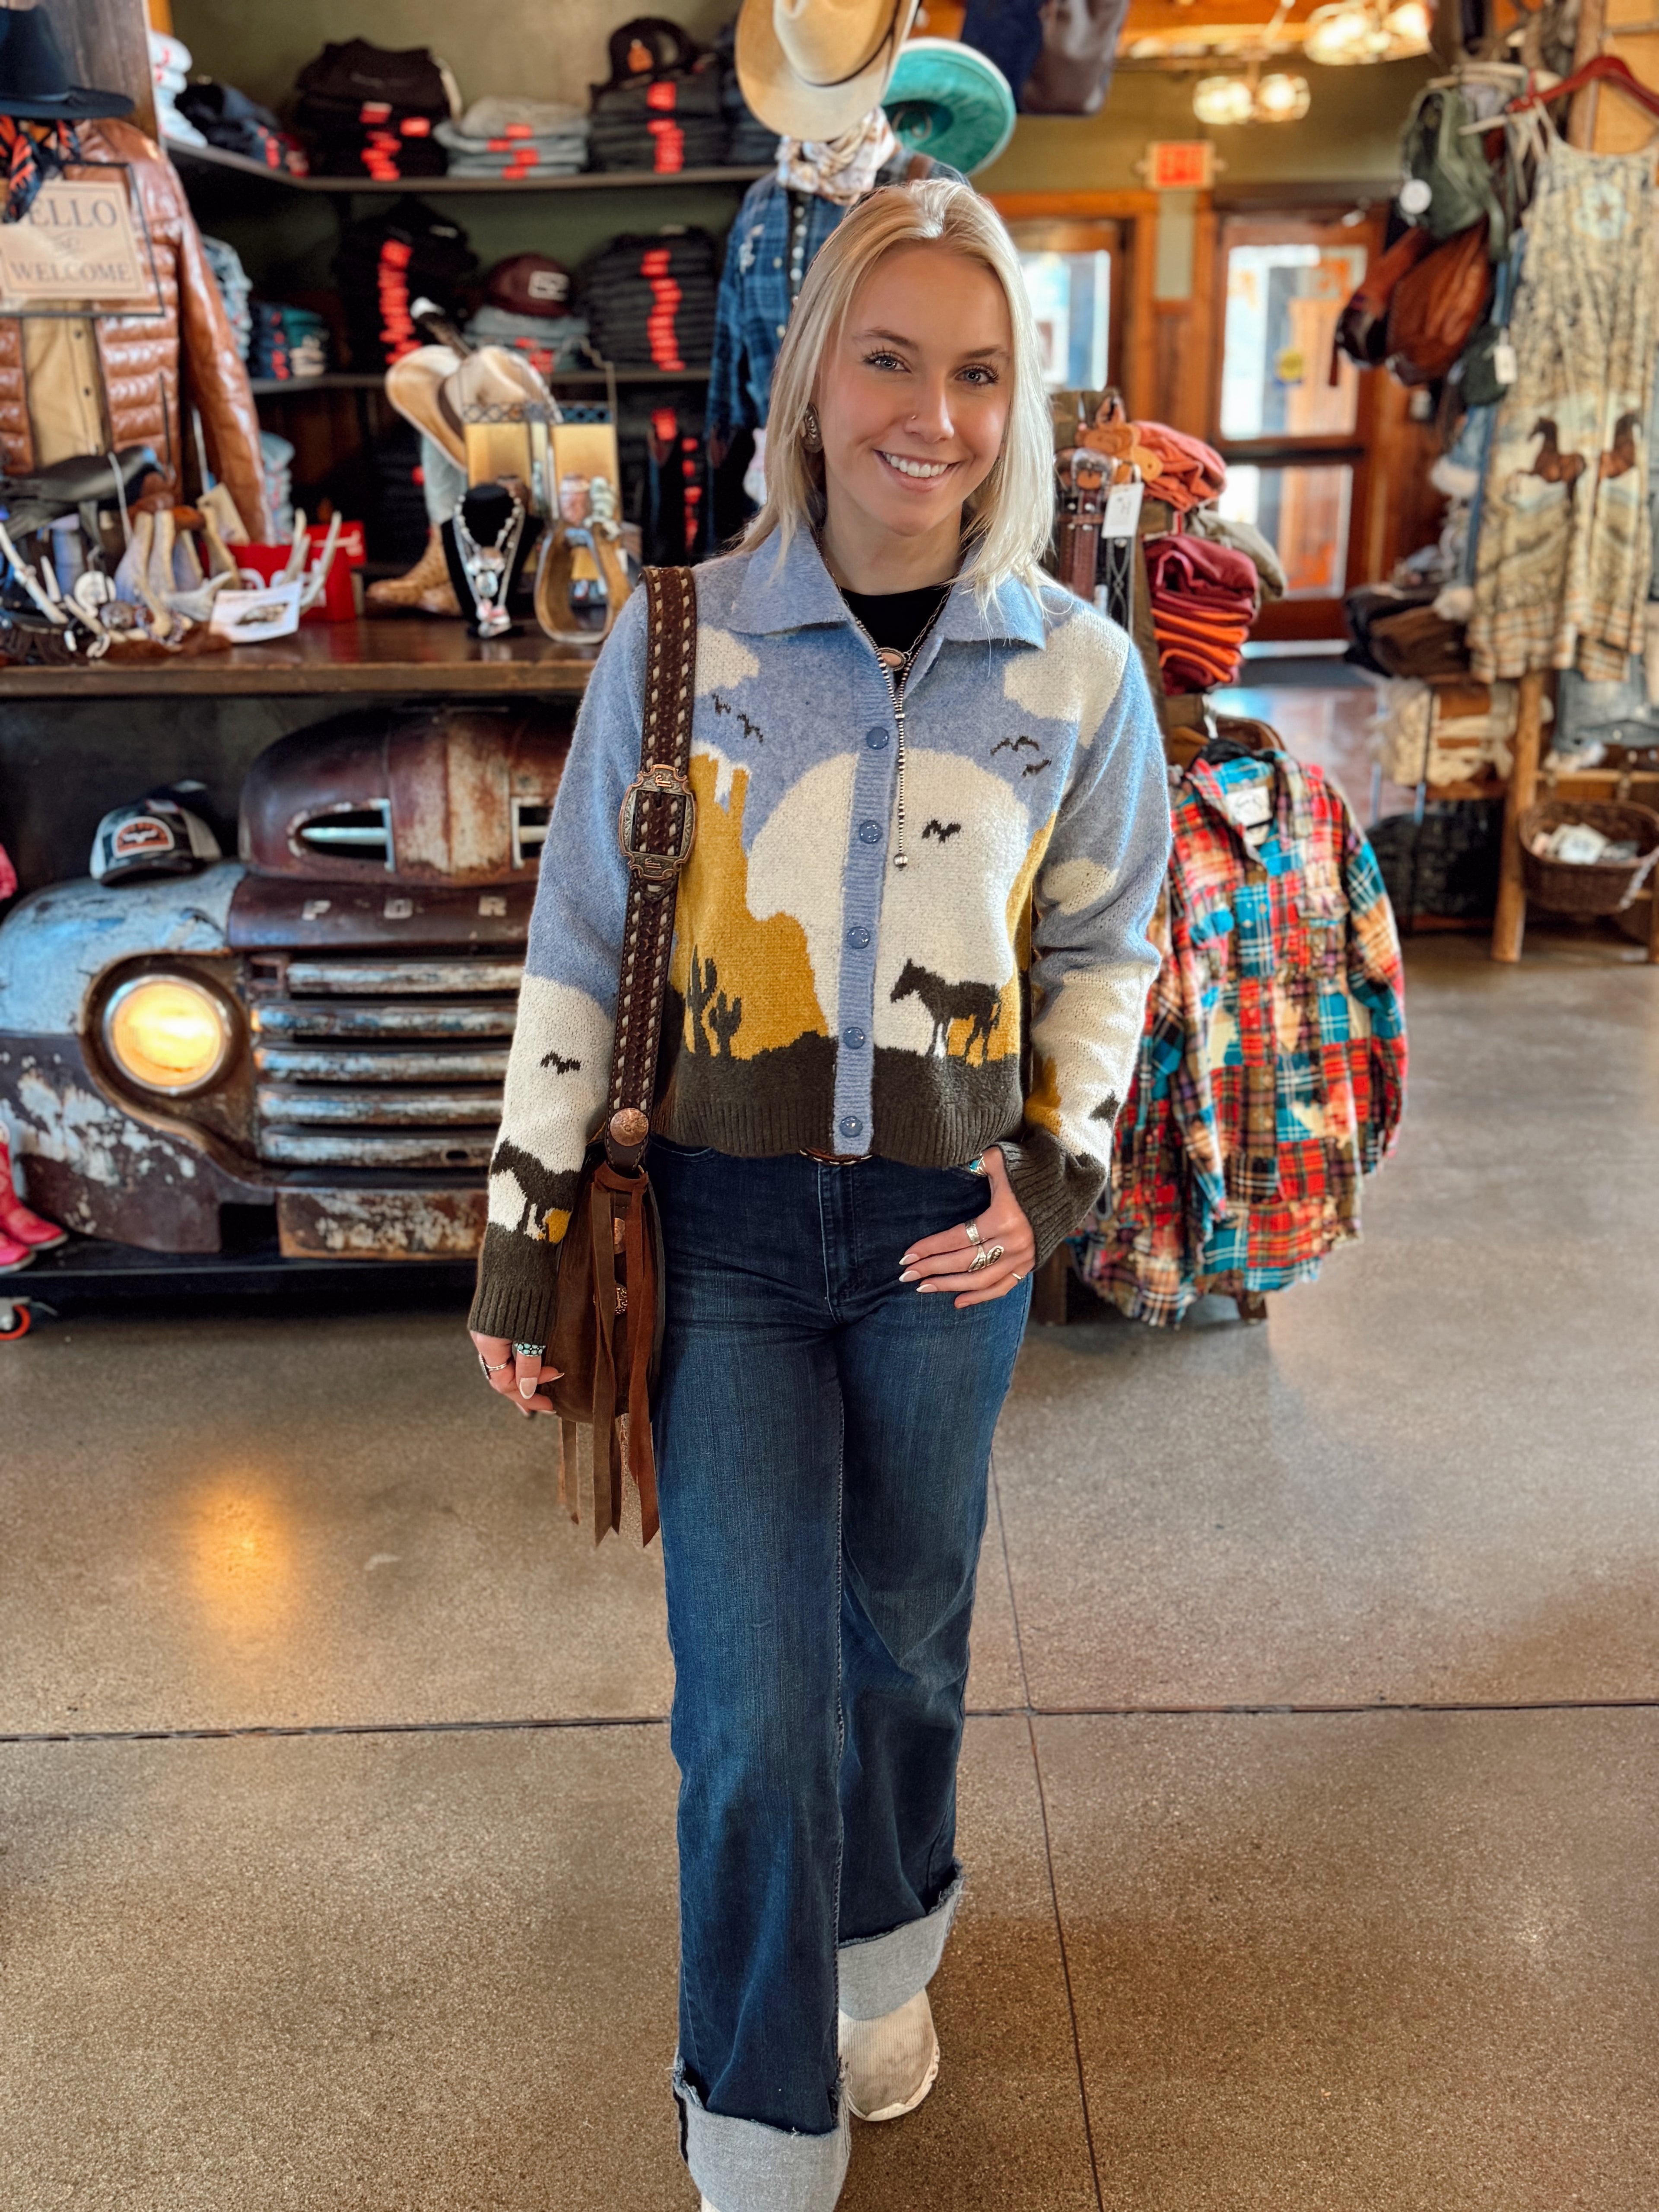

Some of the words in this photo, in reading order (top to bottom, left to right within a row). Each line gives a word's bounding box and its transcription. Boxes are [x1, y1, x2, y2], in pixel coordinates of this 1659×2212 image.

[28, 198, 117, 228] ELLO
[10, 261, 132, 281] WELCOME
[302, 895, 507, 921] FOR
